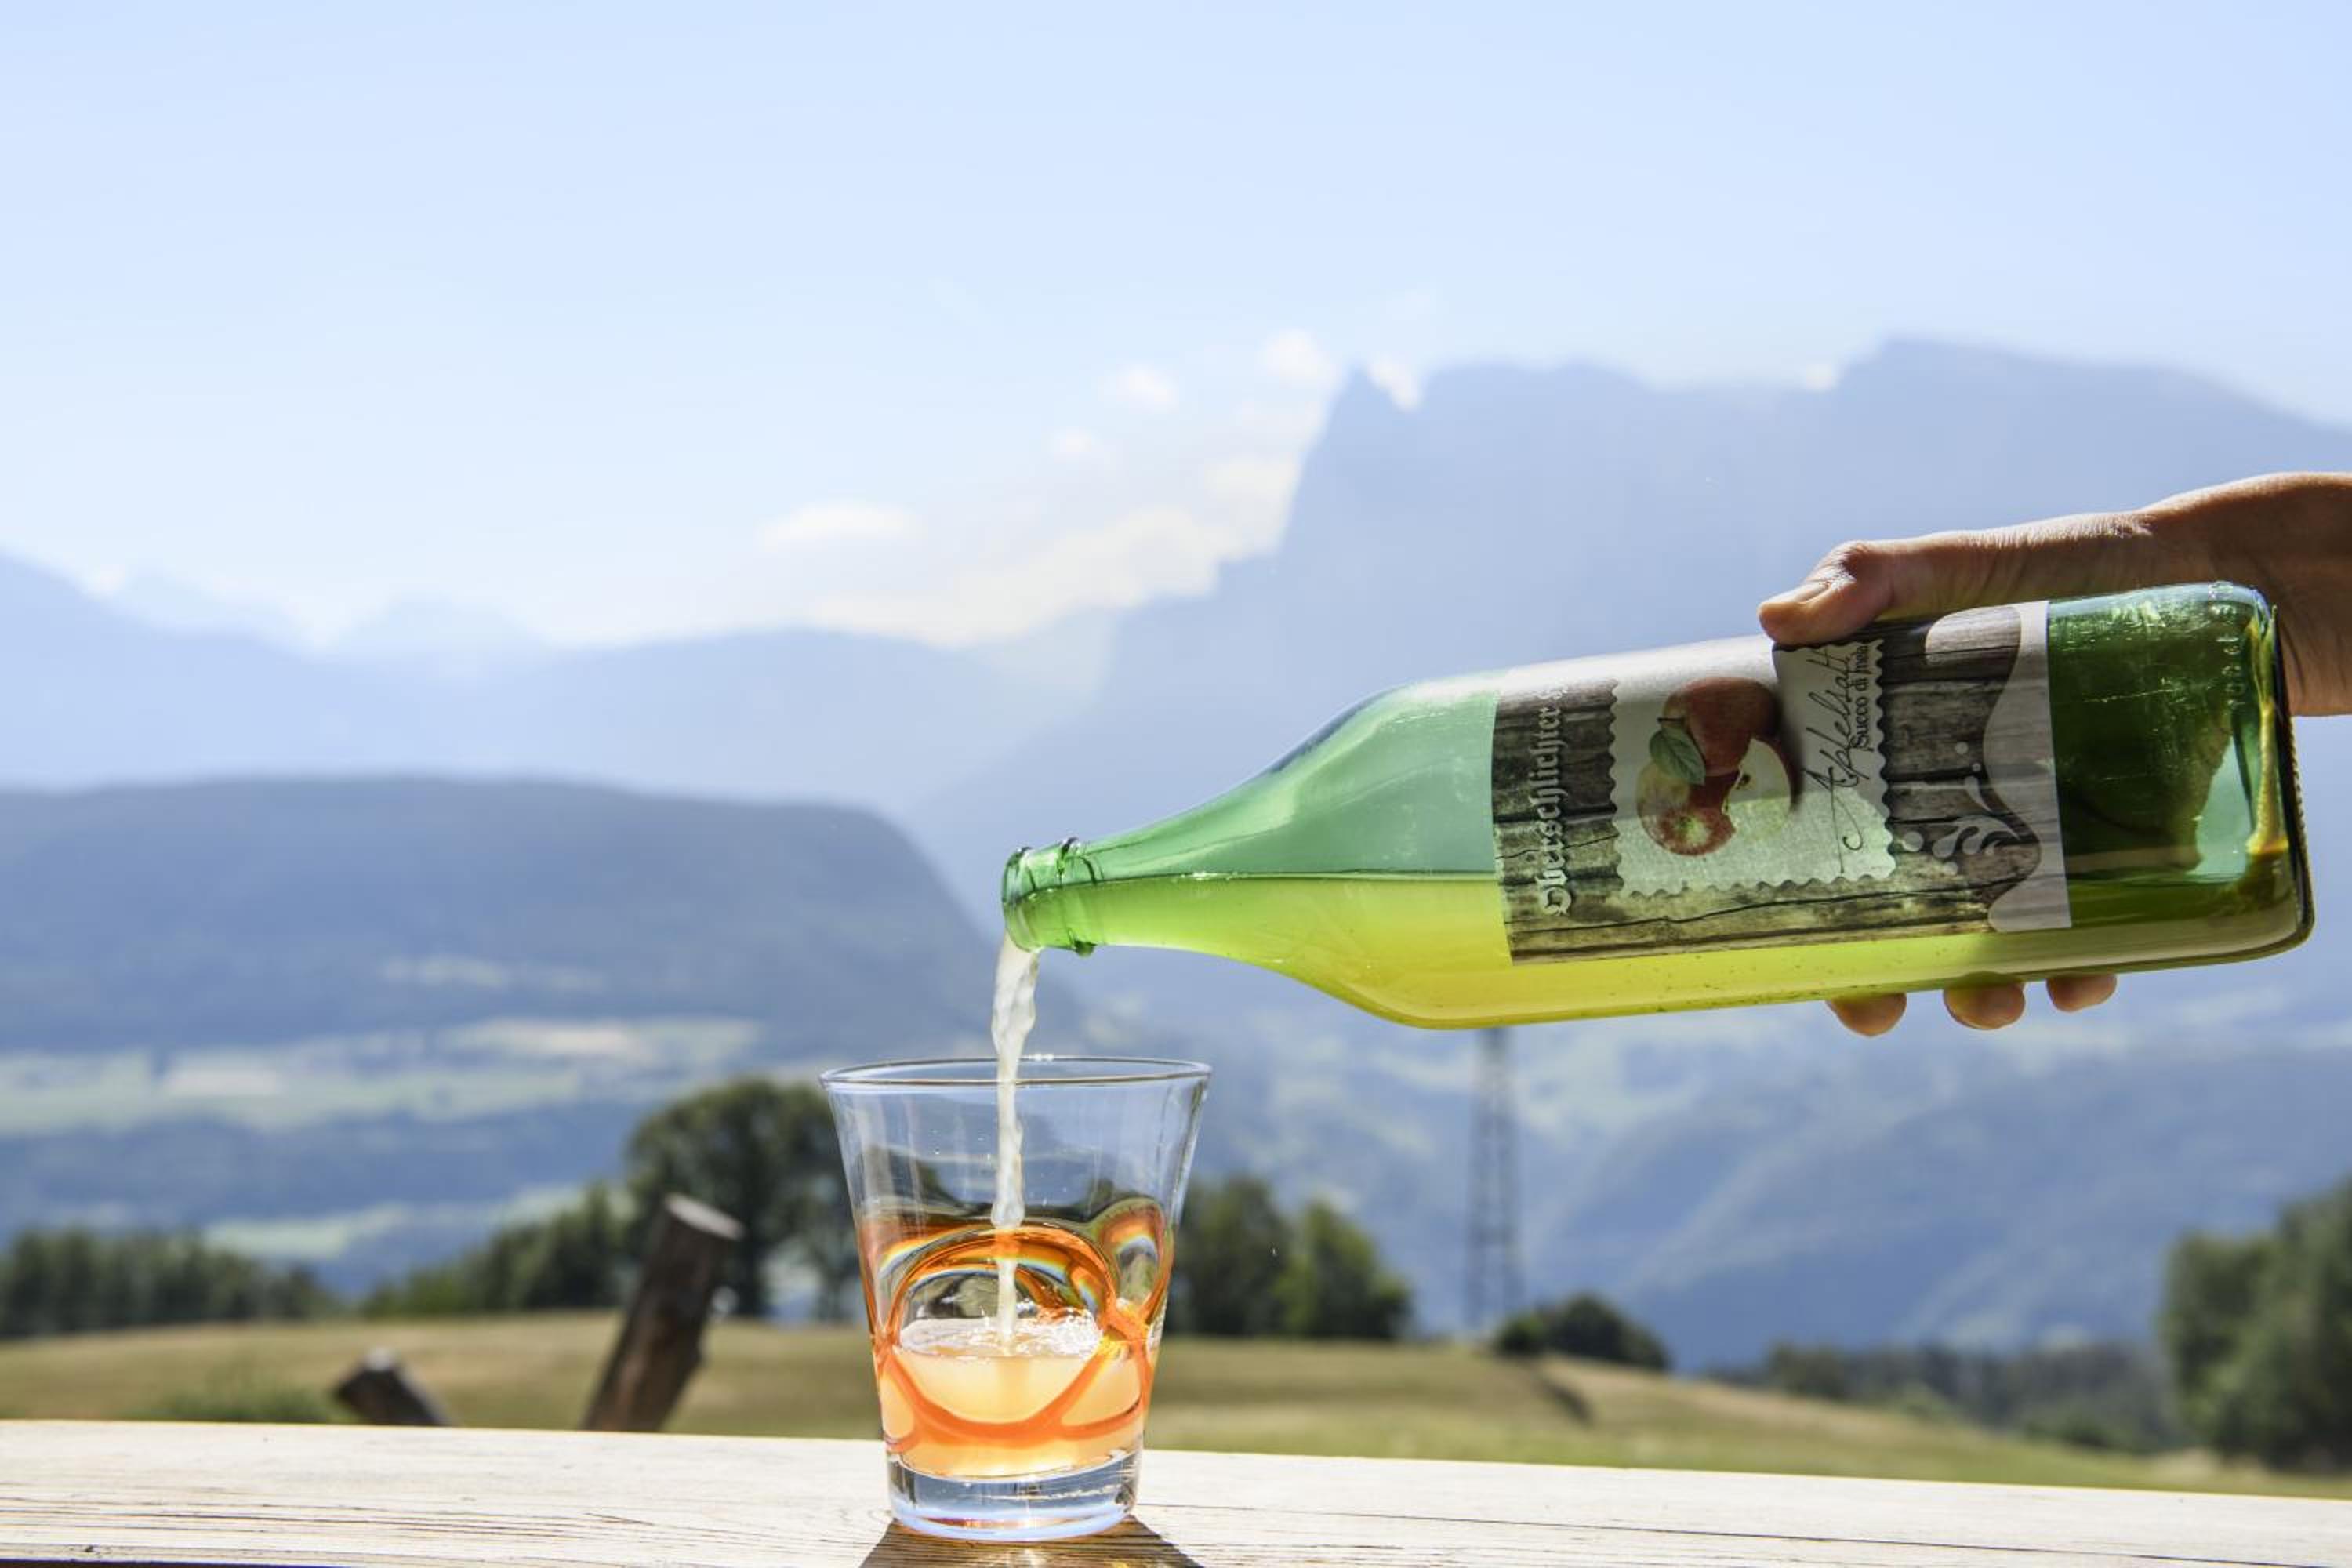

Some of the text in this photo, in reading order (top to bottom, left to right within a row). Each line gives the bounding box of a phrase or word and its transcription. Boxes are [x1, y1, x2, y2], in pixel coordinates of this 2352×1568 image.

[1851, 678, 1868, 691] di
[1852, 696, 1869, 749] Succo
[1802, 647, 1874, 874] Apfelsaft
